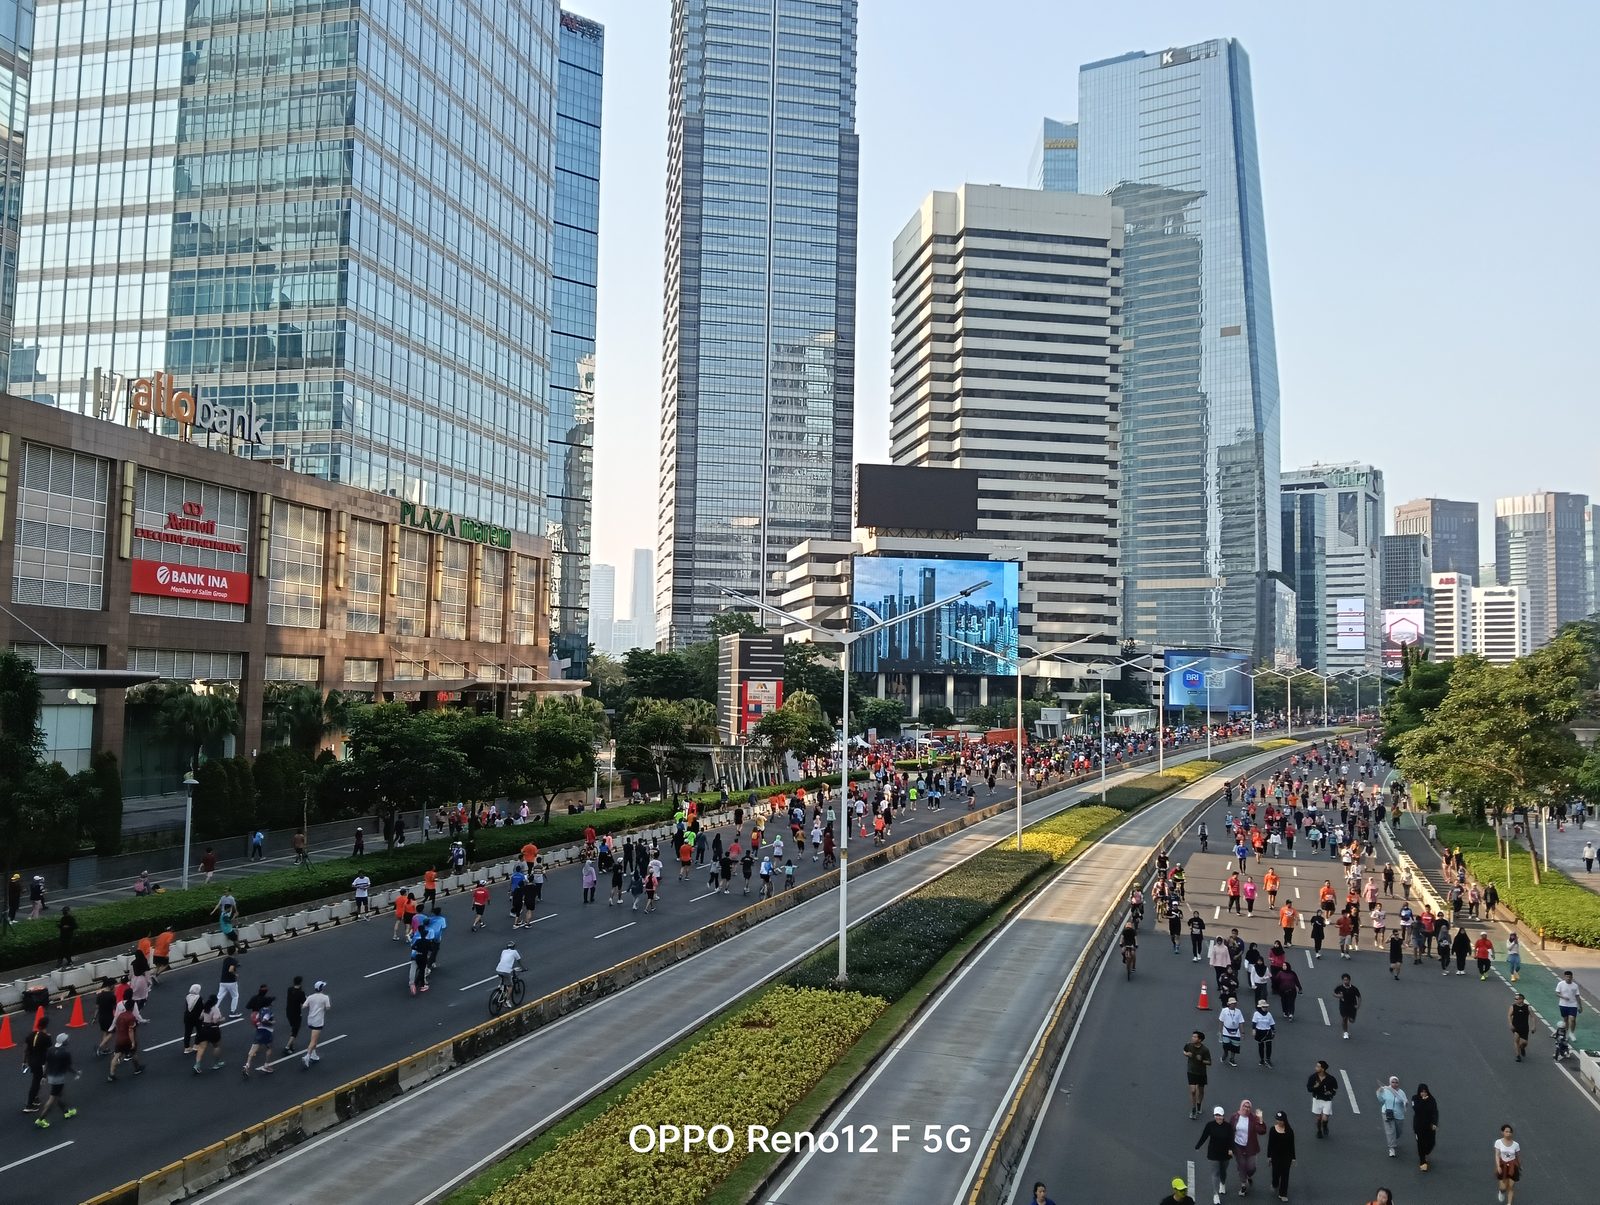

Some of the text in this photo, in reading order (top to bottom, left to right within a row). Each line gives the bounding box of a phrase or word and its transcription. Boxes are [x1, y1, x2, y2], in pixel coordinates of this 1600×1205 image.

[1162, 50, 1174, 65] K
[400, 500, 456, 537] PLAZA
[135, 527, 243, 553] EXECUTIVE APARTMENTS
[171, 570, 229, 589] BANK INA
[1439, 577, 1457, 585] ABB
[170, 585, 192, 595] Member
[198, 588, 212, 597] Salim
[212, 590, 228, 598] Group
[1186, 673, 1199, 681] BRI
